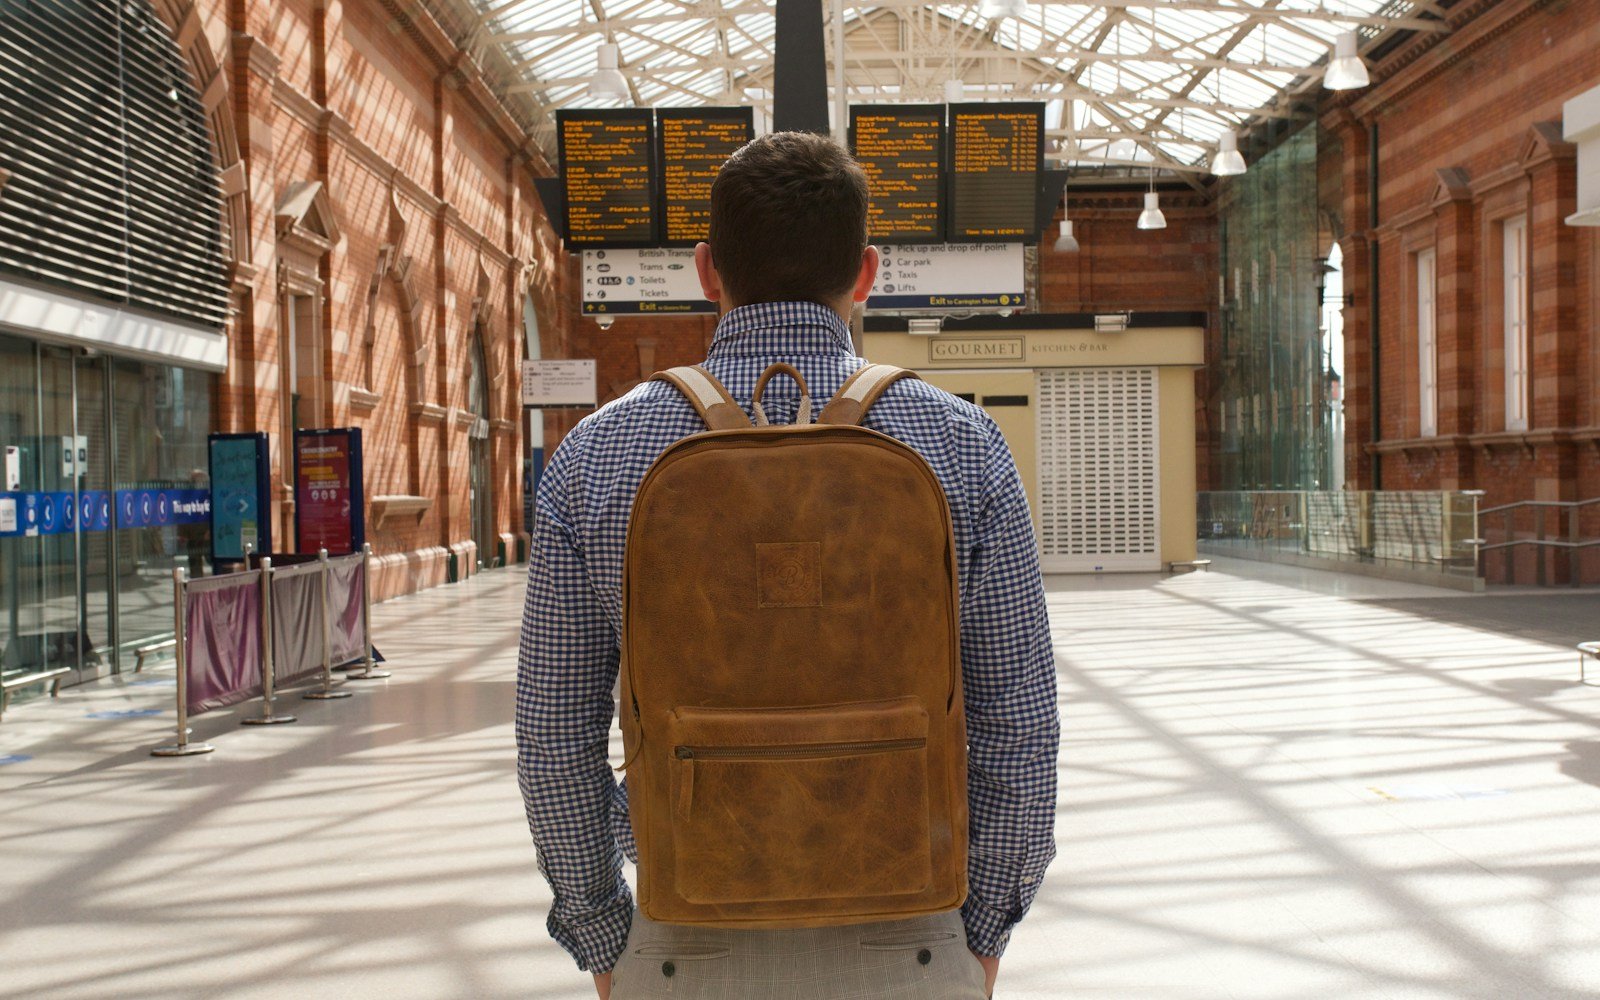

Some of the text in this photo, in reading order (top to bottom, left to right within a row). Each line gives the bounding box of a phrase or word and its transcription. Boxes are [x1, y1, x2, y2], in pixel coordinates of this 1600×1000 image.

[948, 244, 967, 254] drop
[970, 244, 982, 252] off
[984, 244, 1008, 253] point
[638, 249, 696, 259] British Transp
[914, 258, 931, 268] park
[898, 270, 917, 278] Taxis
[898, 284, 916, 292] Lifts
[930, 296, 946, 305] Exit
[640, 302, 656, 310] Exit
[935, 343, 1018, 355] GOURMET
[1079, 343, 1088, 352] &
